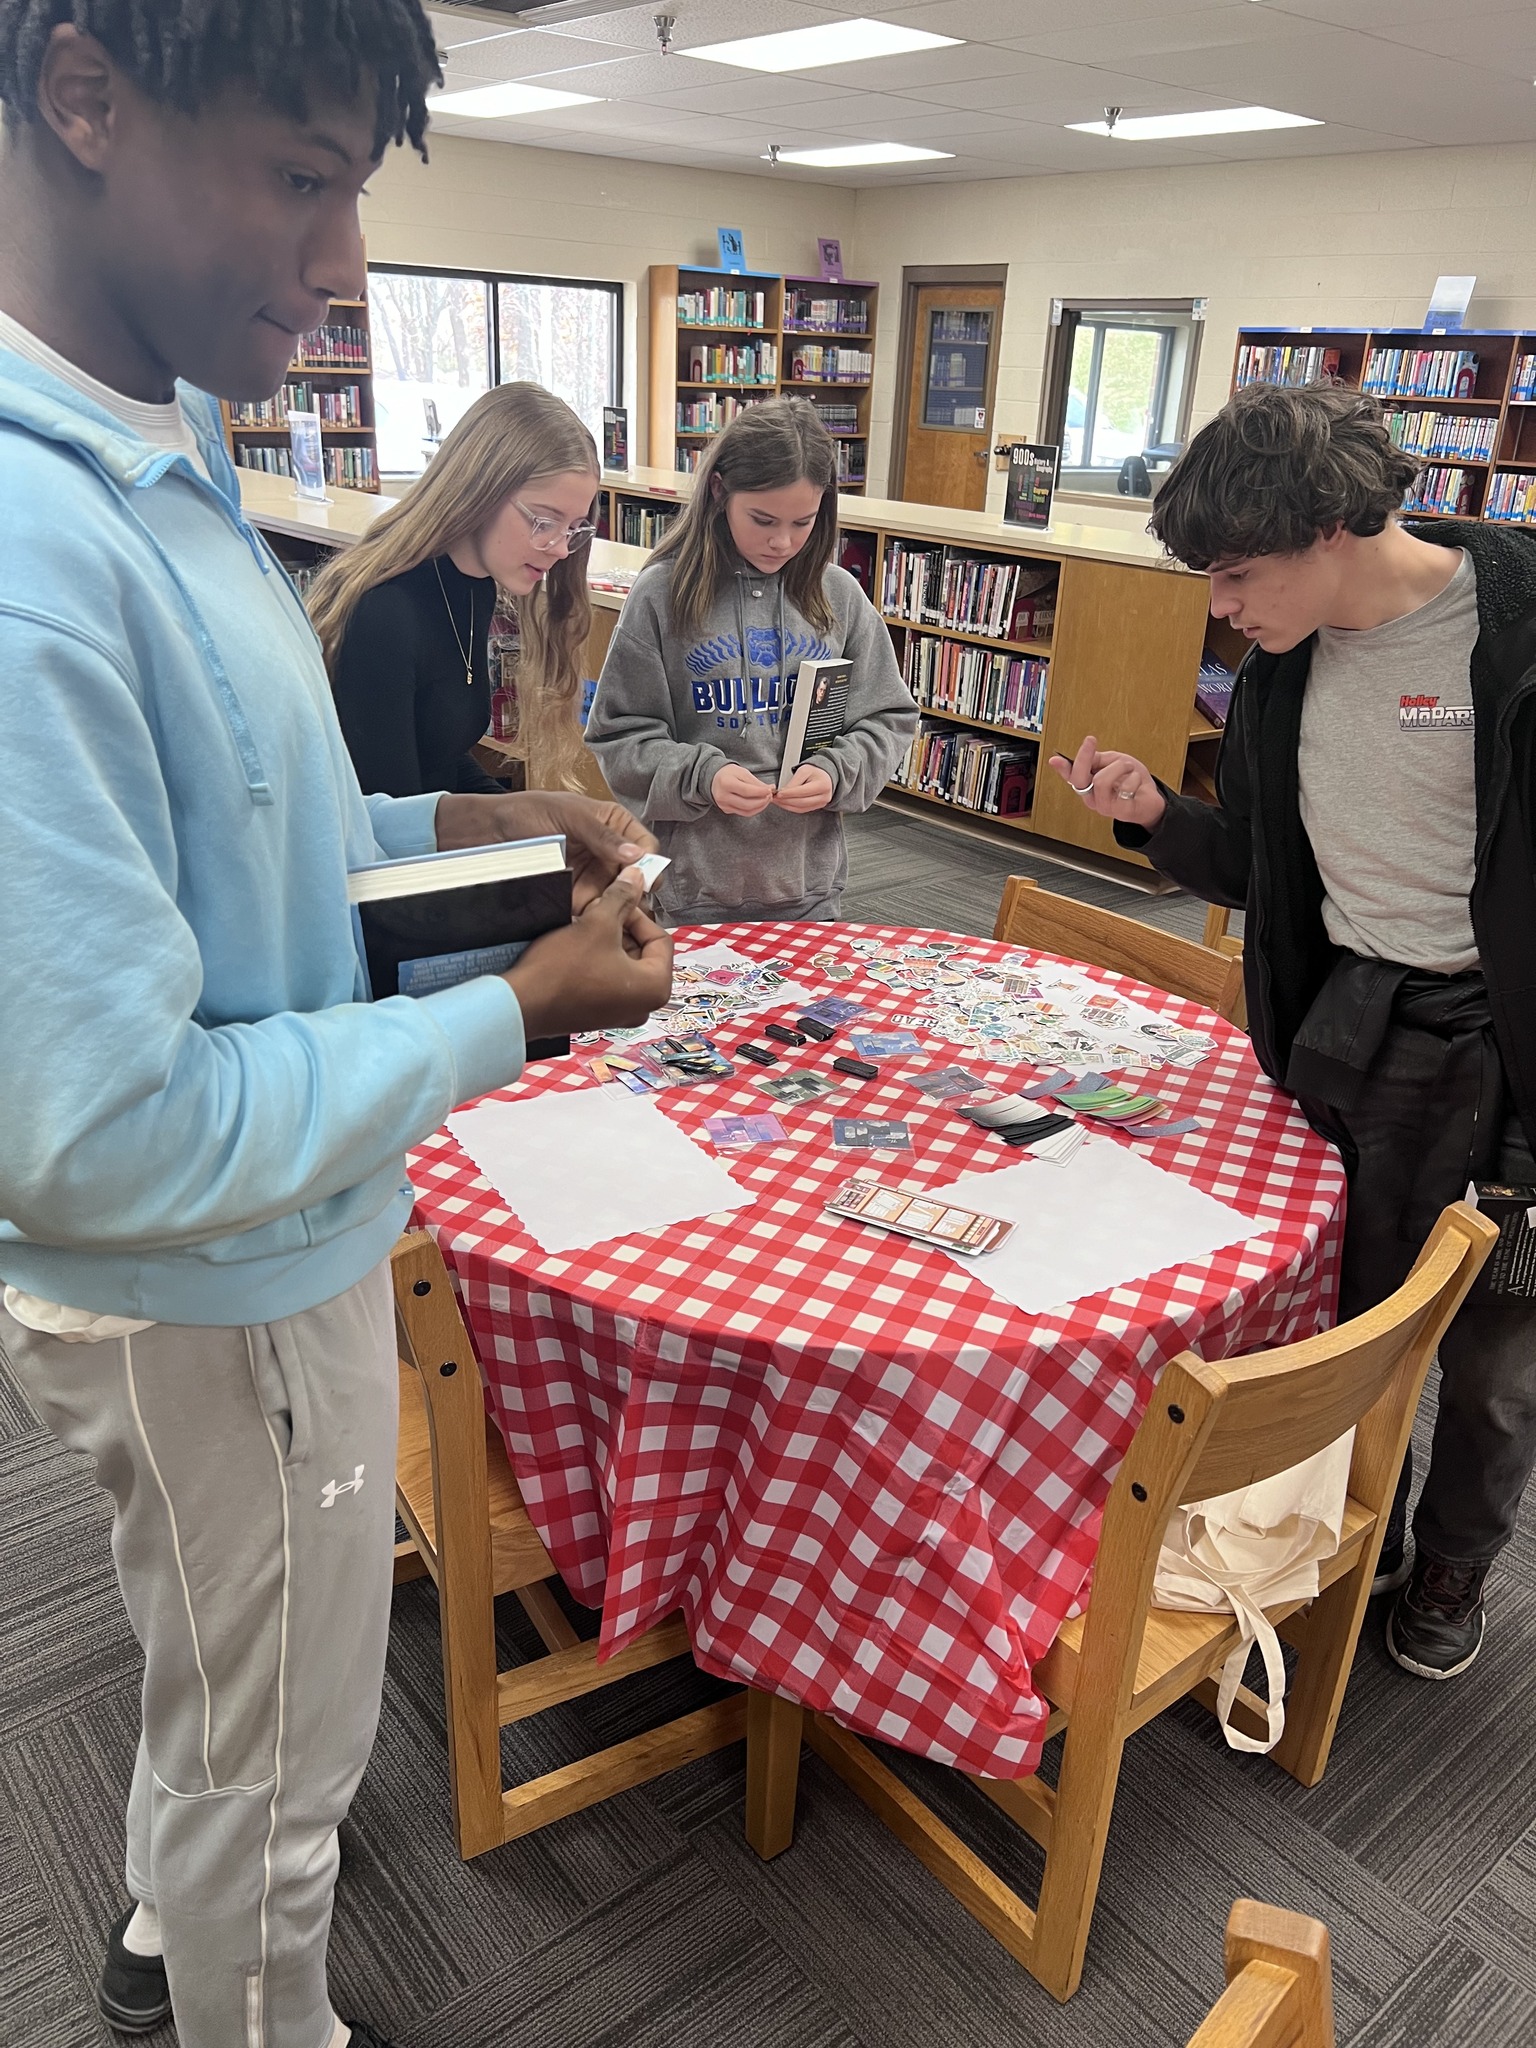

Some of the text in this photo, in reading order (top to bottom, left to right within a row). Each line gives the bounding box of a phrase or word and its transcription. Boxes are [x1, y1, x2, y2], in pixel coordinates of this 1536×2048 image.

[1013, 447, 1035, 466] 900s
[691, 673, 800, 715] BULLDO
[1400, 694, 1438, 707] Holley
[892, 1014, 940, 1028] READ
